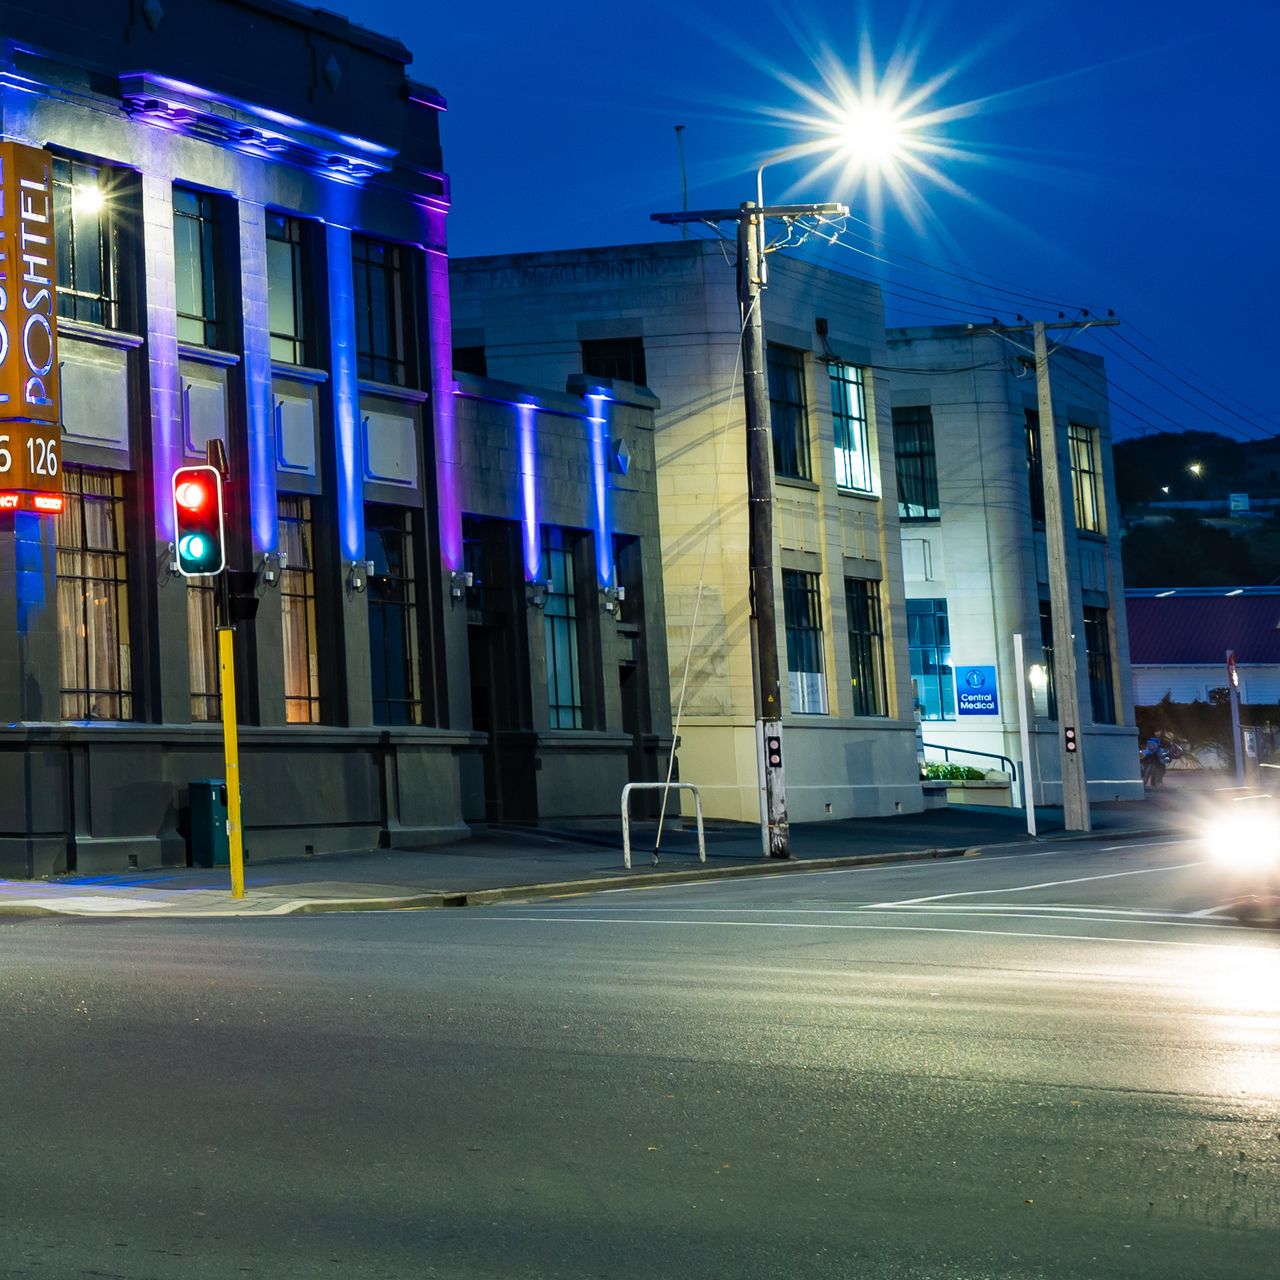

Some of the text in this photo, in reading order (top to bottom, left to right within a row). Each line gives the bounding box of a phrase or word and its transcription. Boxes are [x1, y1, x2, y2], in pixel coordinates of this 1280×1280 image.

[19, 164, 55, 406] POSHTEL
[26, 437, 58, 476] 126
[960, 701, 995, 709] Medical
[961, 693, 992, 701] Central
